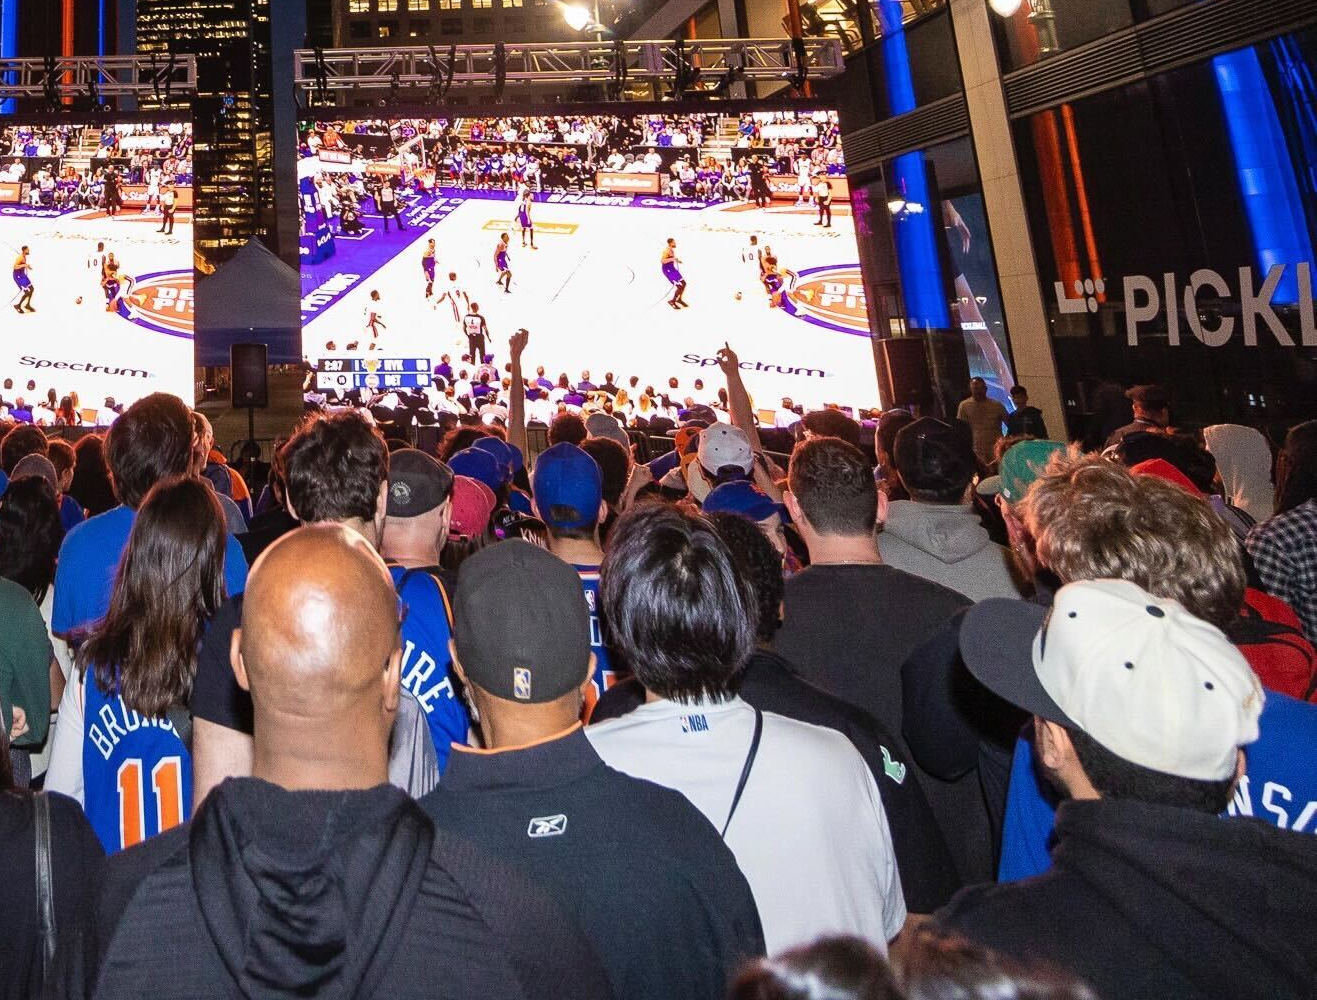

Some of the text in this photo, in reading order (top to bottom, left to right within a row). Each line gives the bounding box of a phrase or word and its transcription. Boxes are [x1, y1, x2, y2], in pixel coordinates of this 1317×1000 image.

[1123, 262, 1317, 347] PICKL
[19, 355, 148, 378] Spectrum
[682, 353, 825, 378] Spctrum
[688, 714, 709, 732] NBA
[117, 755, 184, 850] 11
